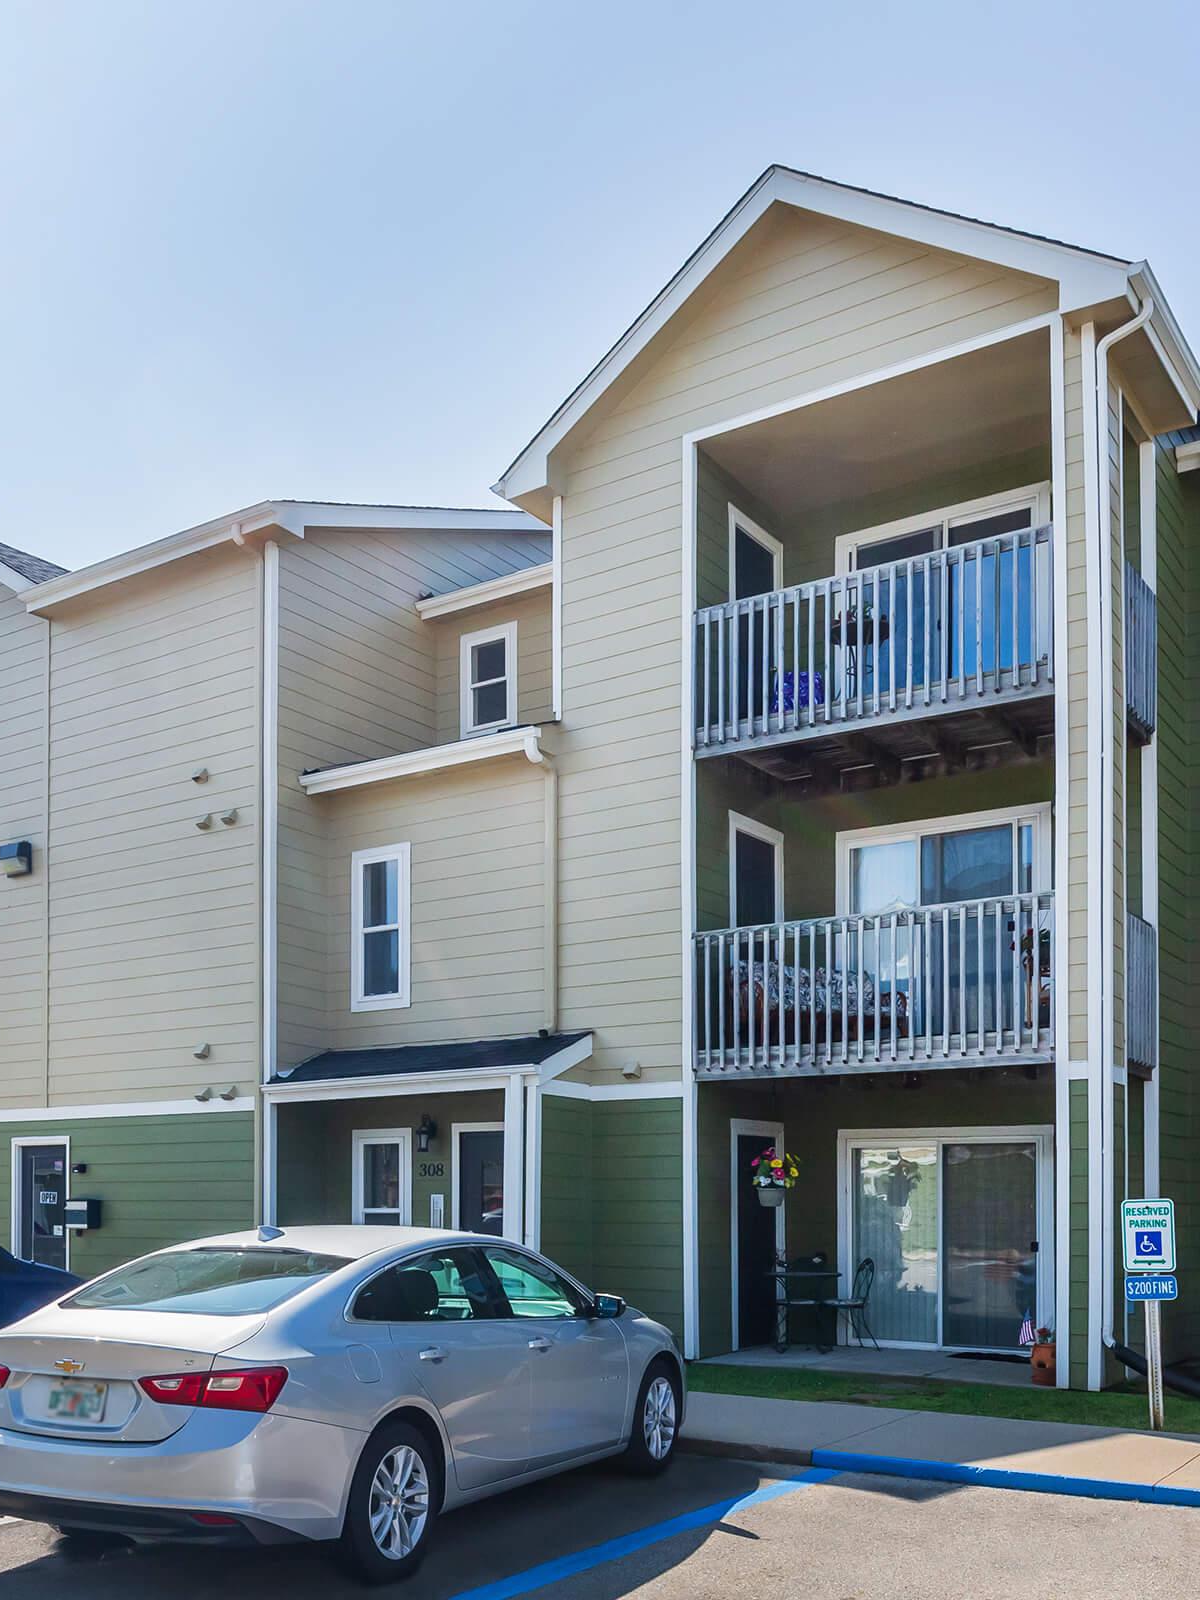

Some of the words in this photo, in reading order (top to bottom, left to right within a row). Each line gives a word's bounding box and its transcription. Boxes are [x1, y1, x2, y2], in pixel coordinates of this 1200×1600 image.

[419, 1163, 444, 1177] 308
[41, 1192, 57, 1203] OPEN
[1125, 1207, 1170, 1216] RESERVED
[1129, 1219, 1167, 1228] PARKING
